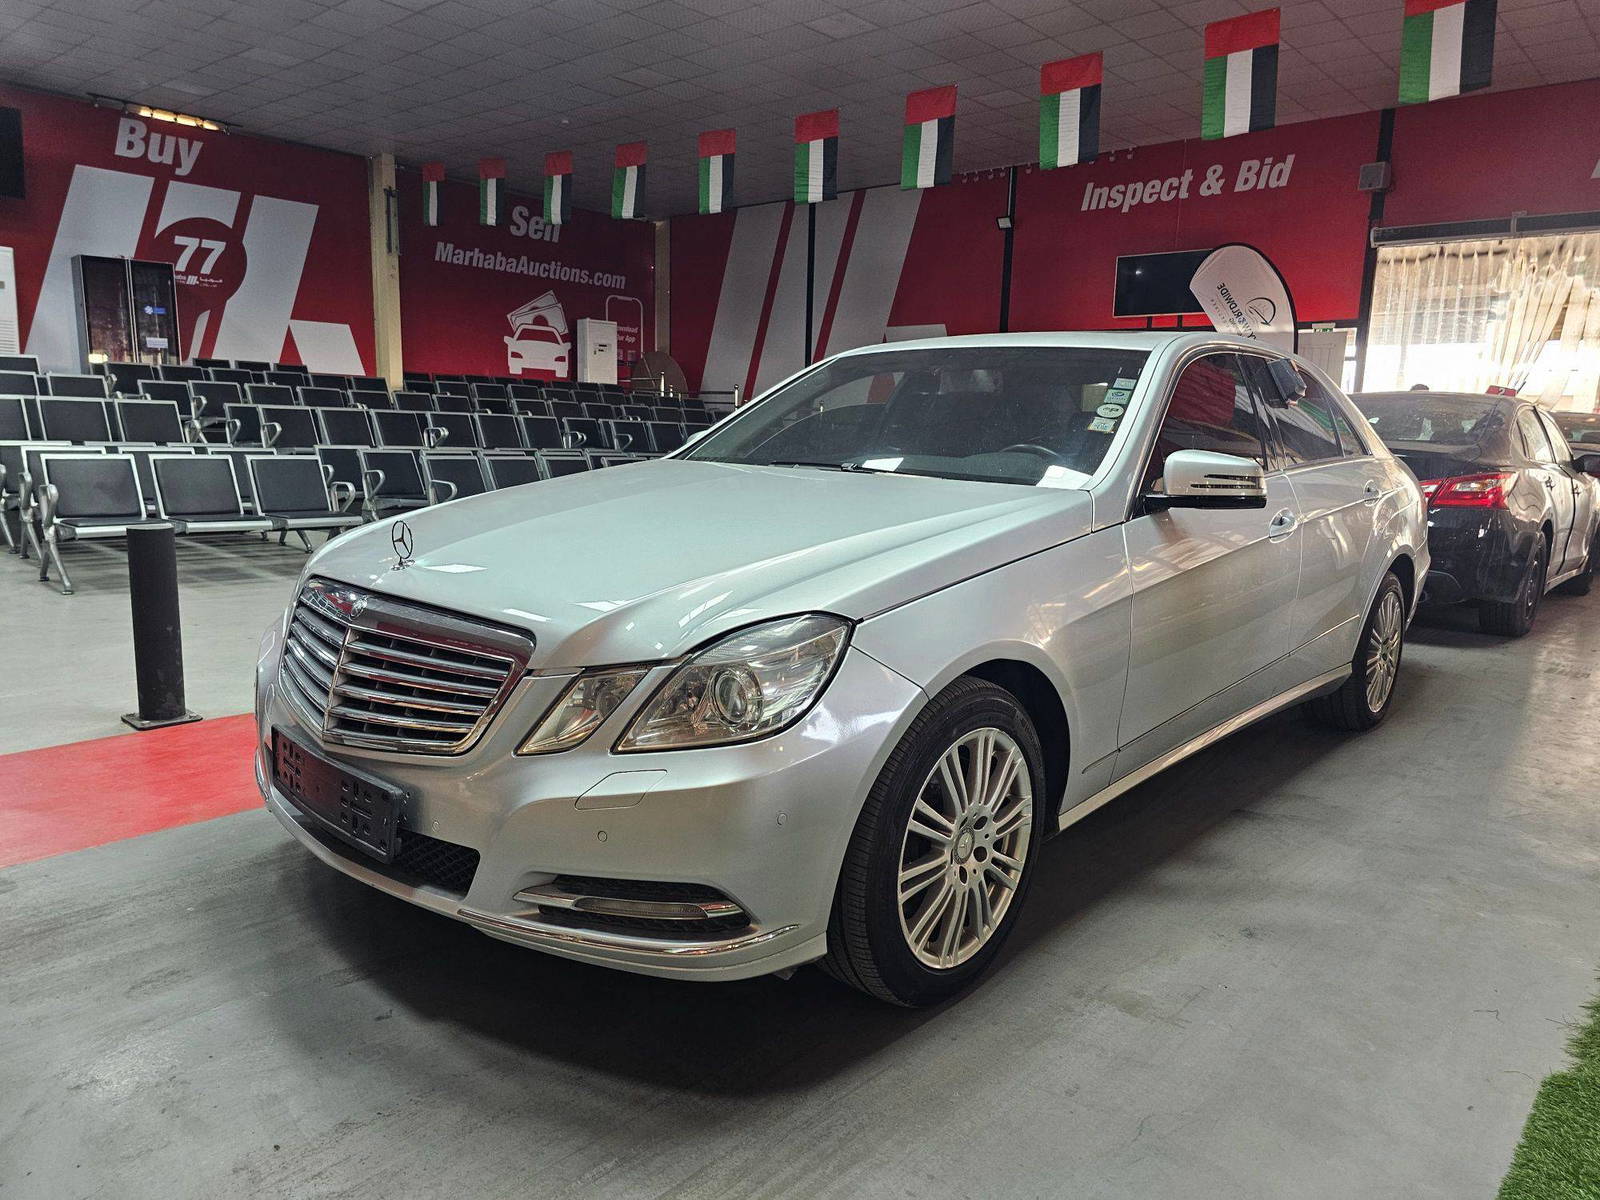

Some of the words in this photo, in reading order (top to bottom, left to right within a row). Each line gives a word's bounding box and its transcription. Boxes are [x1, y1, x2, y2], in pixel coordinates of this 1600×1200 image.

[114, 117, 204, 176] Buy
[1081, 169, 1193, 213] Inspect
[1200, 164, 1225, 196] &
[1234, 154, 1295, 193] Bid
[174, 235, 226, 275] 77
[434, 241, 626, 290] MarhabaAuctions.com
